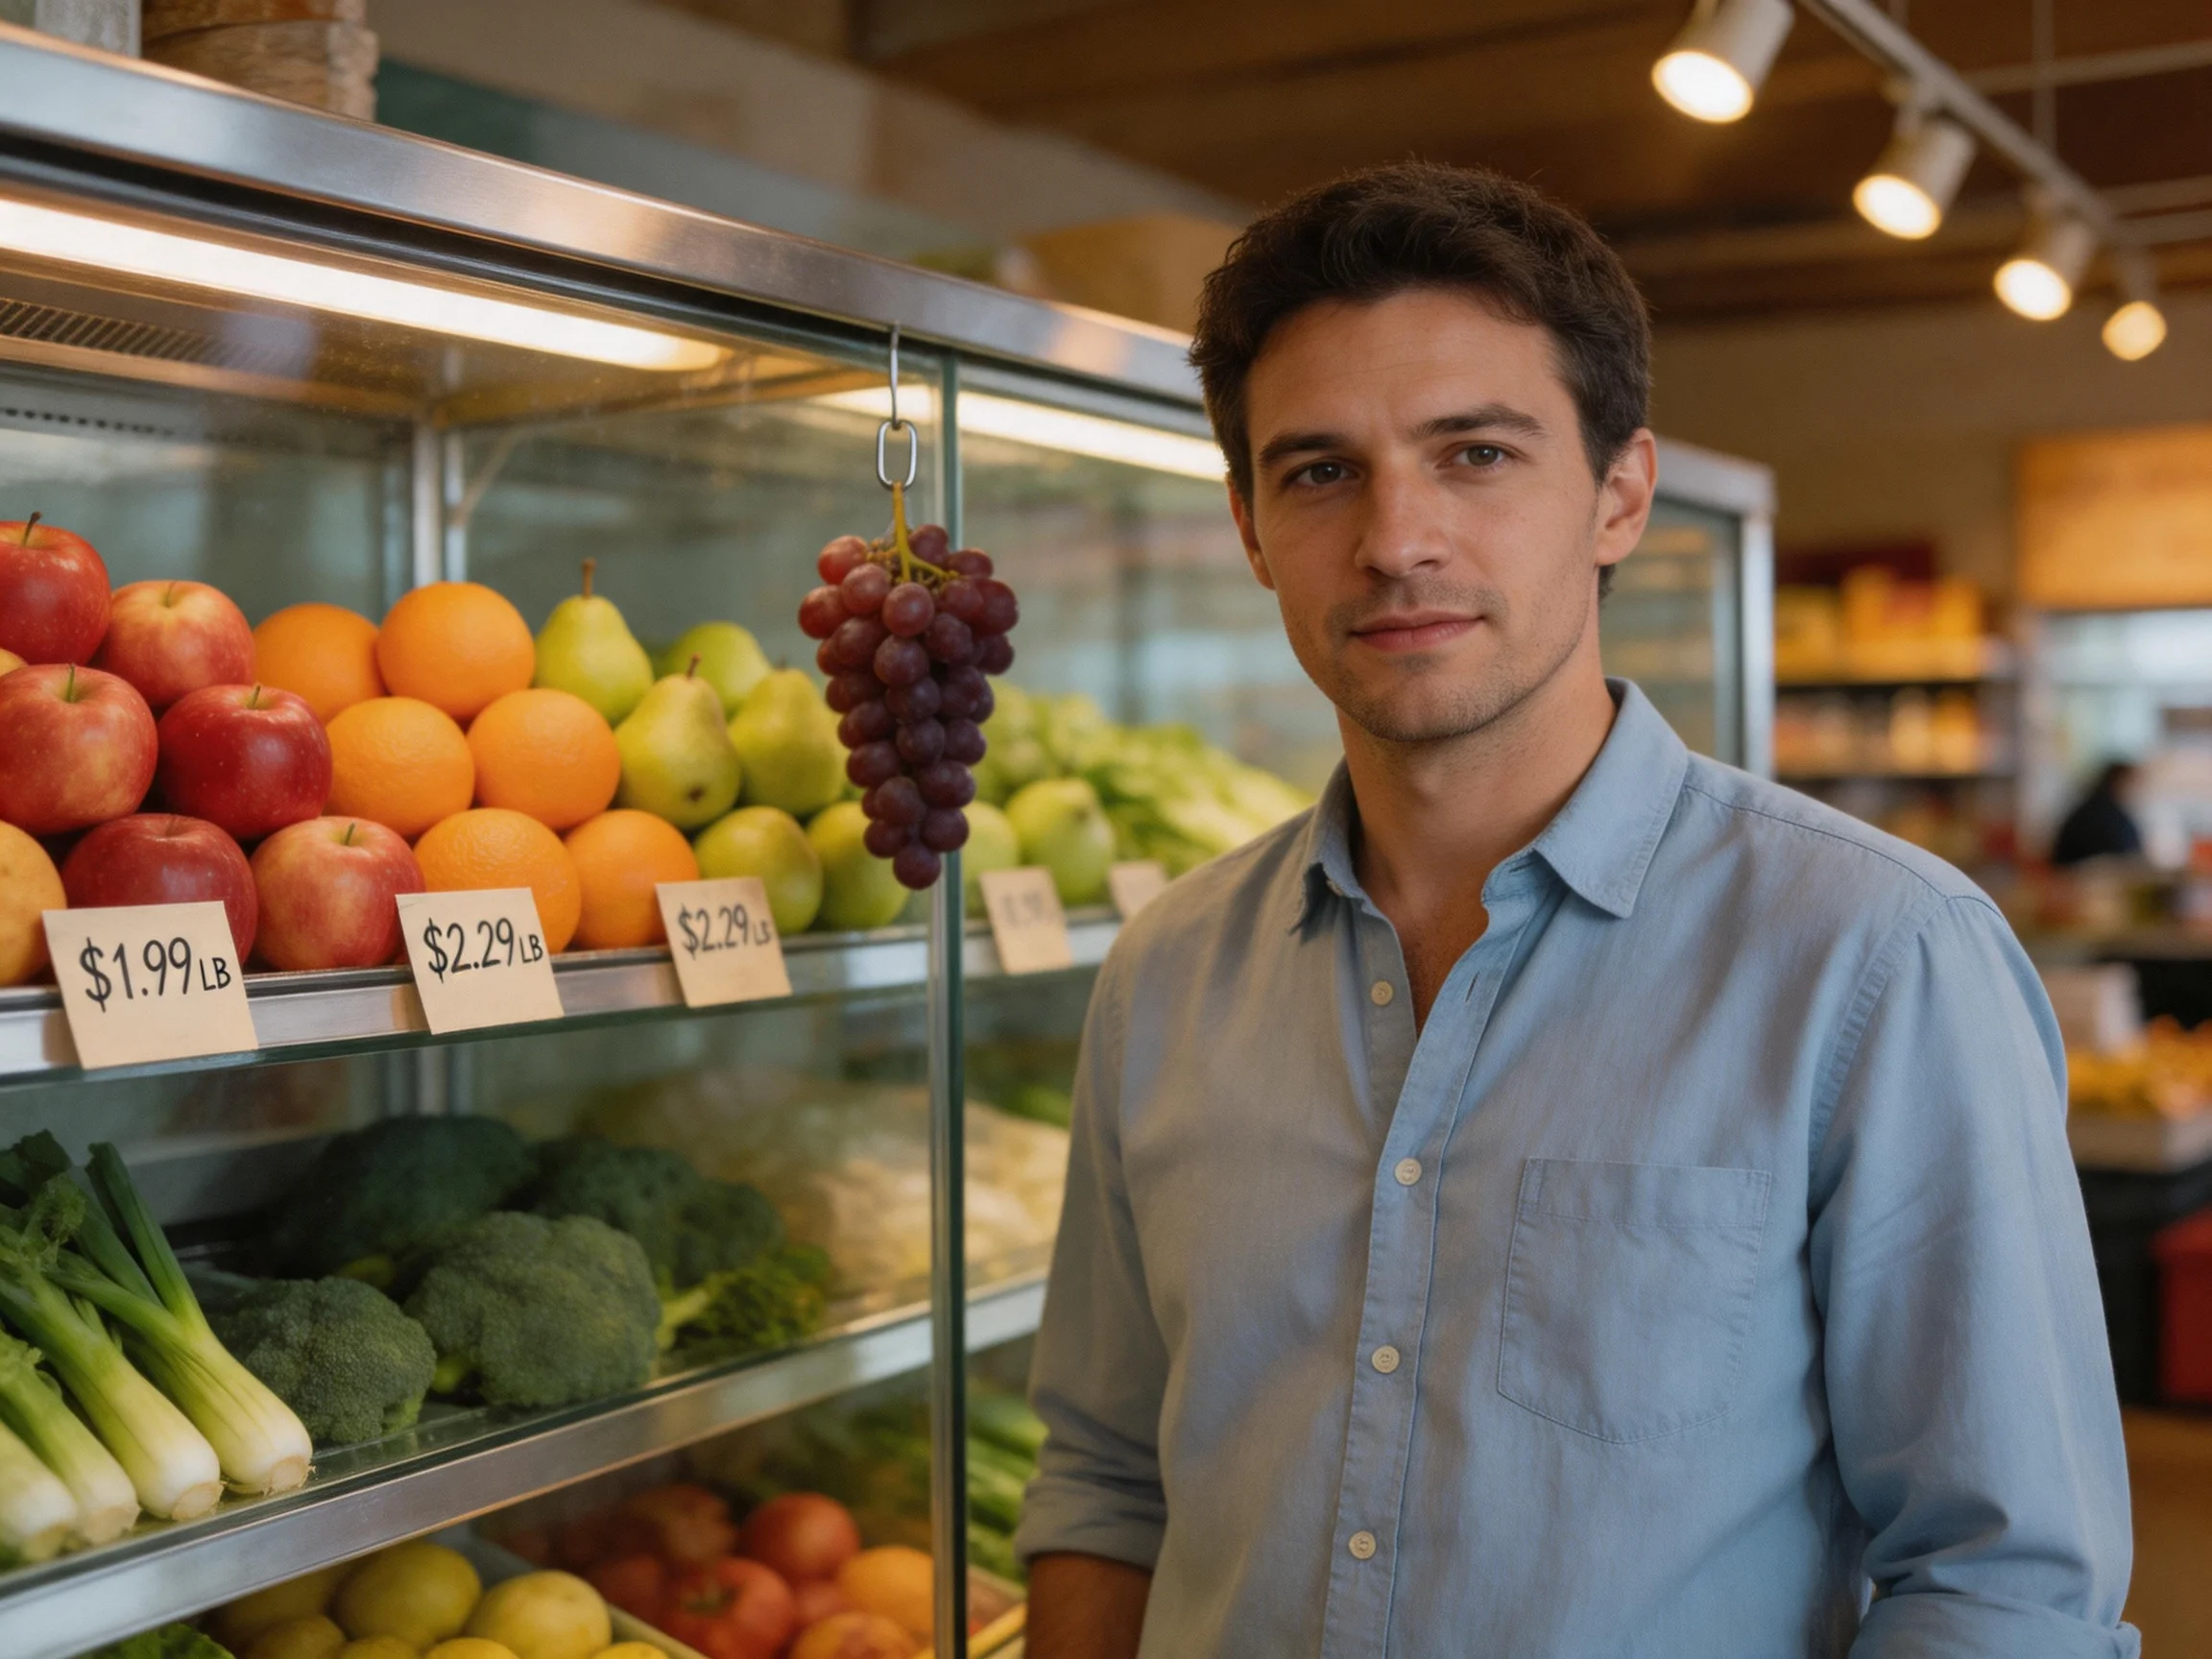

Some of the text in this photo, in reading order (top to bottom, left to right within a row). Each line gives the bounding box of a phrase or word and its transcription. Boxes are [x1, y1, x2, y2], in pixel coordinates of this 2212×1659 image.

[422, 917, 543, 983] $2.29 LB
[677, 903, 749, 961] $2.29
[80, 937, 231, 1013] $1.99 LB
